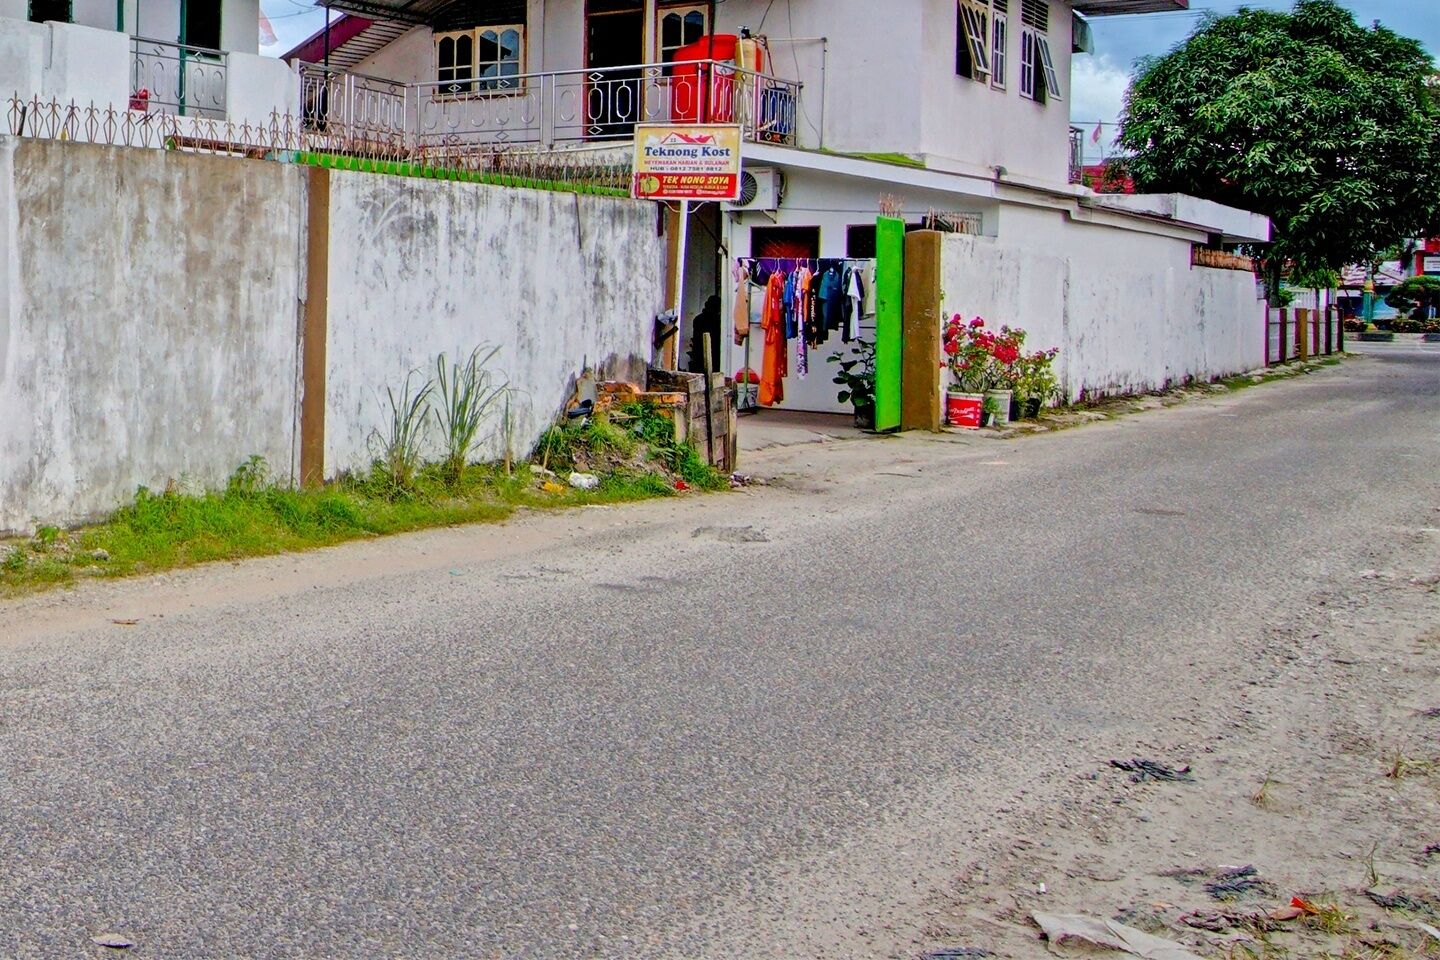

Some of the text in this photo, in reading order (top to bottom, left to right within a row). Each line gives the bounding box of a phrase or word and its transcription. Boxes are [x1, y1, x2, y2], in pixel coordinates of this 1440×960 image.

[645, 146, 730, 158] Teknong Kost
[662, 176, 729, 184] TEK NONG SOYA
